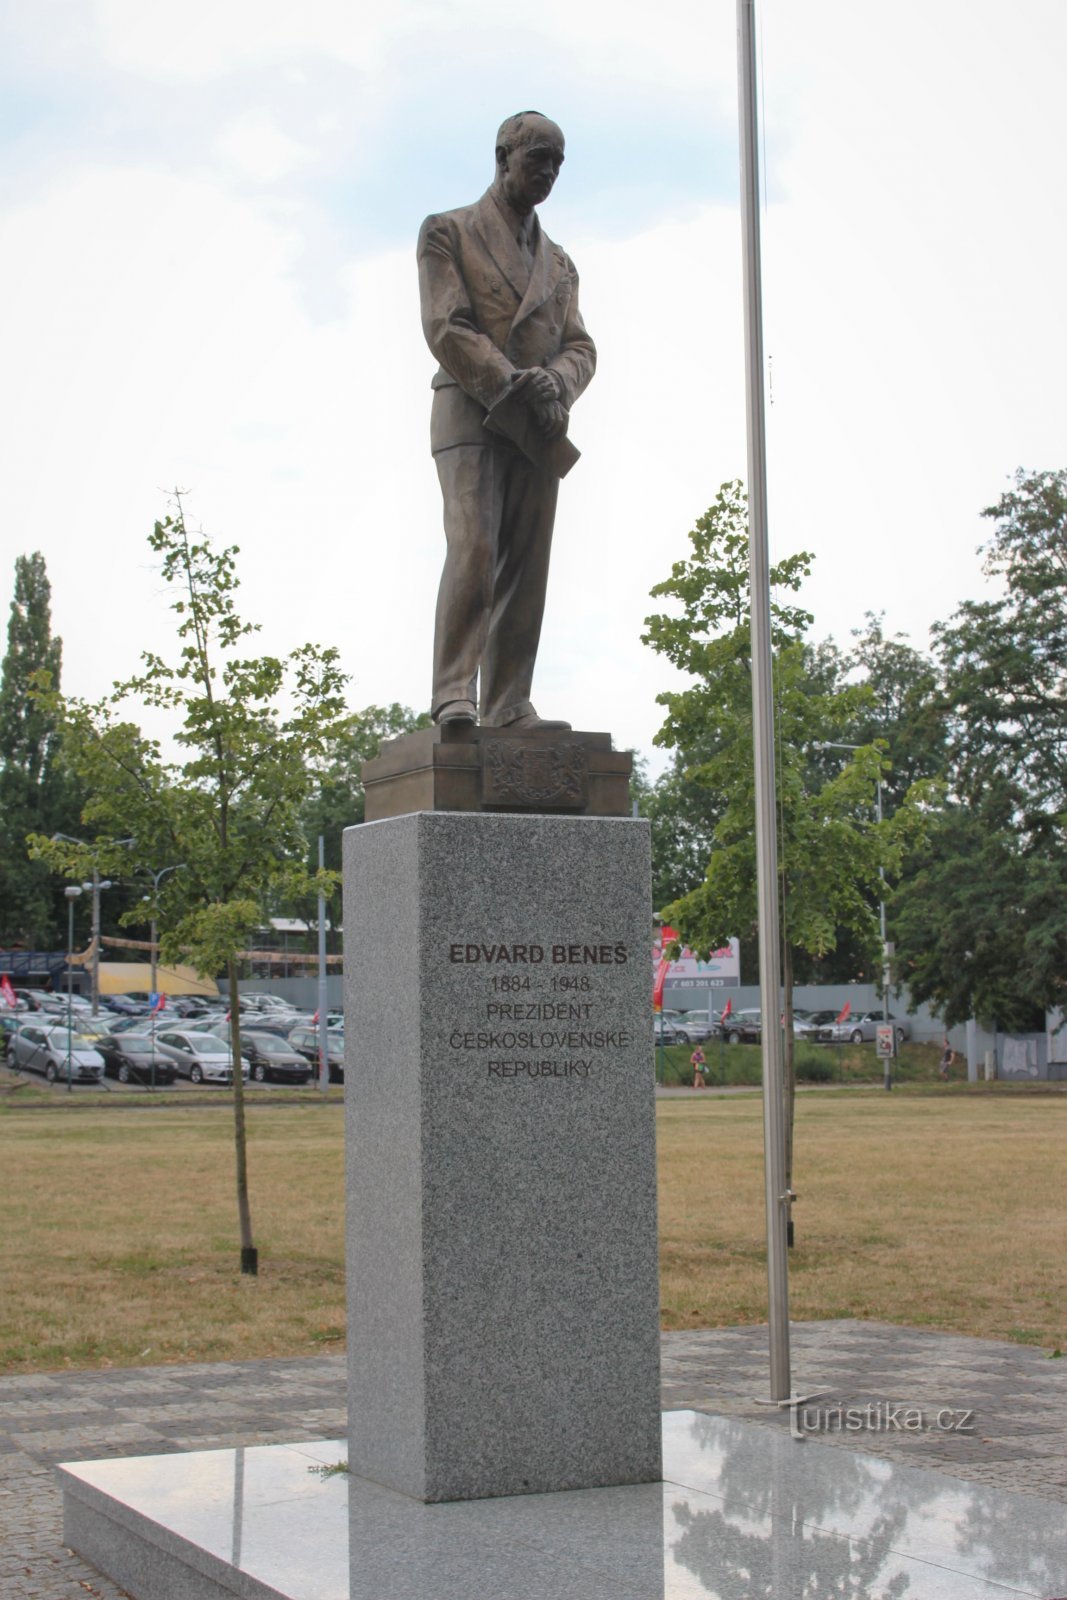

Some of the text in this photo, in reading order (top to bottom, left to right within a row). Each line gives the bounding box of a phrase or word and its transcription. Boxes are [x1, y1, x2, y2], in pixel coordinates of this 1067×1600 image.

[449, 944, 544, 964] EDVARD
[552, 941, 628, 964] BENEŠ
[492, 976, 530, 991] 1884
[551, 976, 590, 991] 1948
[486, 1003, 593, 1020] PREZIDENT
[449, 1029, 630, 1049] ČESKOSLOVENSKÉ
[488, 1060, 593, 1077] REPUBLIKY
